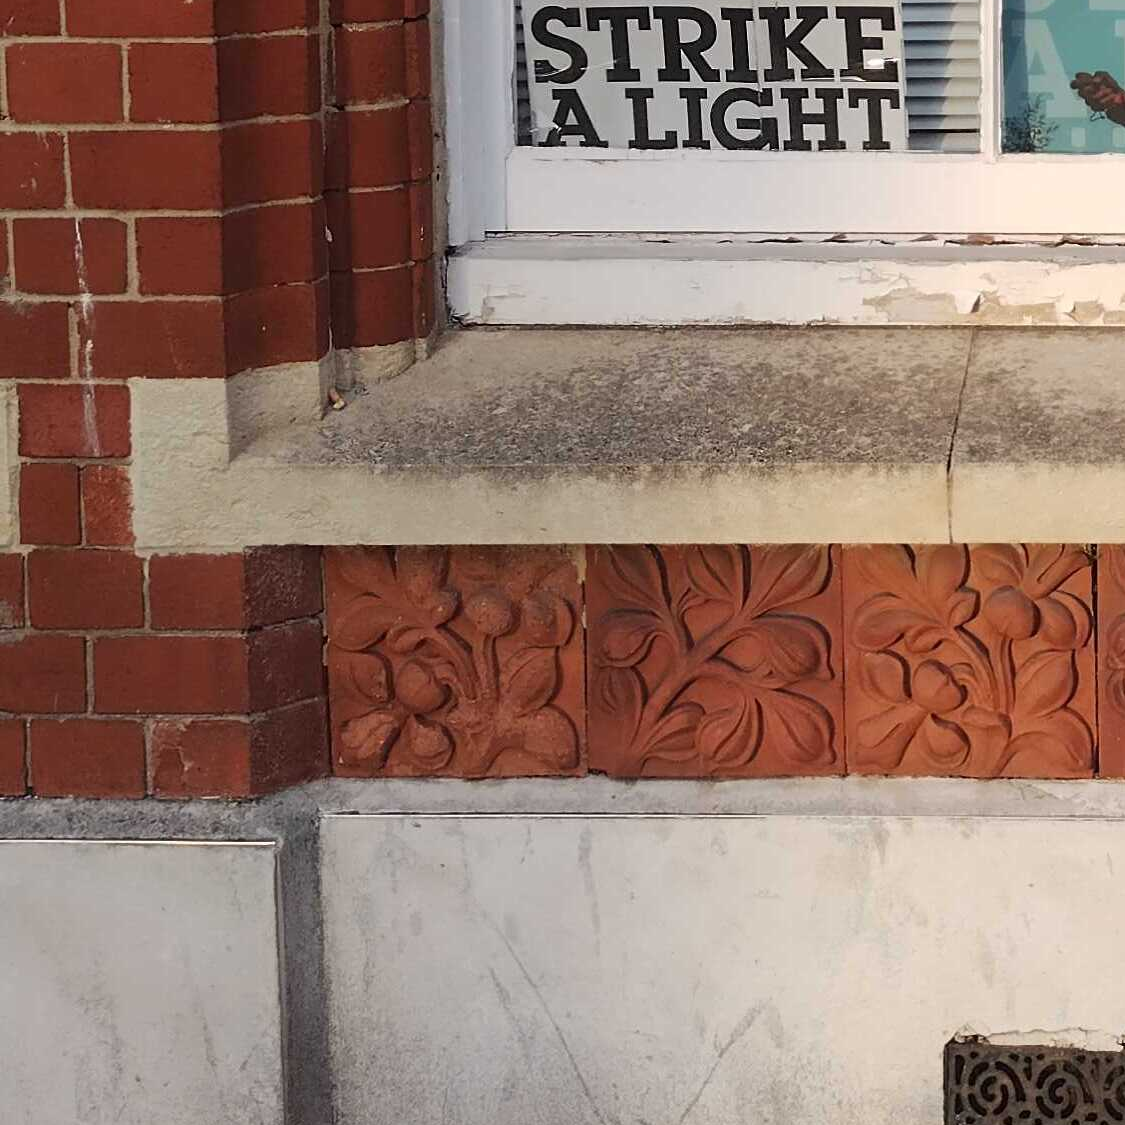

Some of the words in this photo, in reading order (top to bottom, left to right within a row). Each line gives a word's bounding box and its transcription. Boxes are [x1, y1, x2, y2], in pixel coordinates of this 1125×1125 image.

[531, 5, 899, 83] STRIKE
[1006, 18, 1084, 119] A
[538, 88, 608, 147] A
[625, 87, 900, 150] LIGHT
